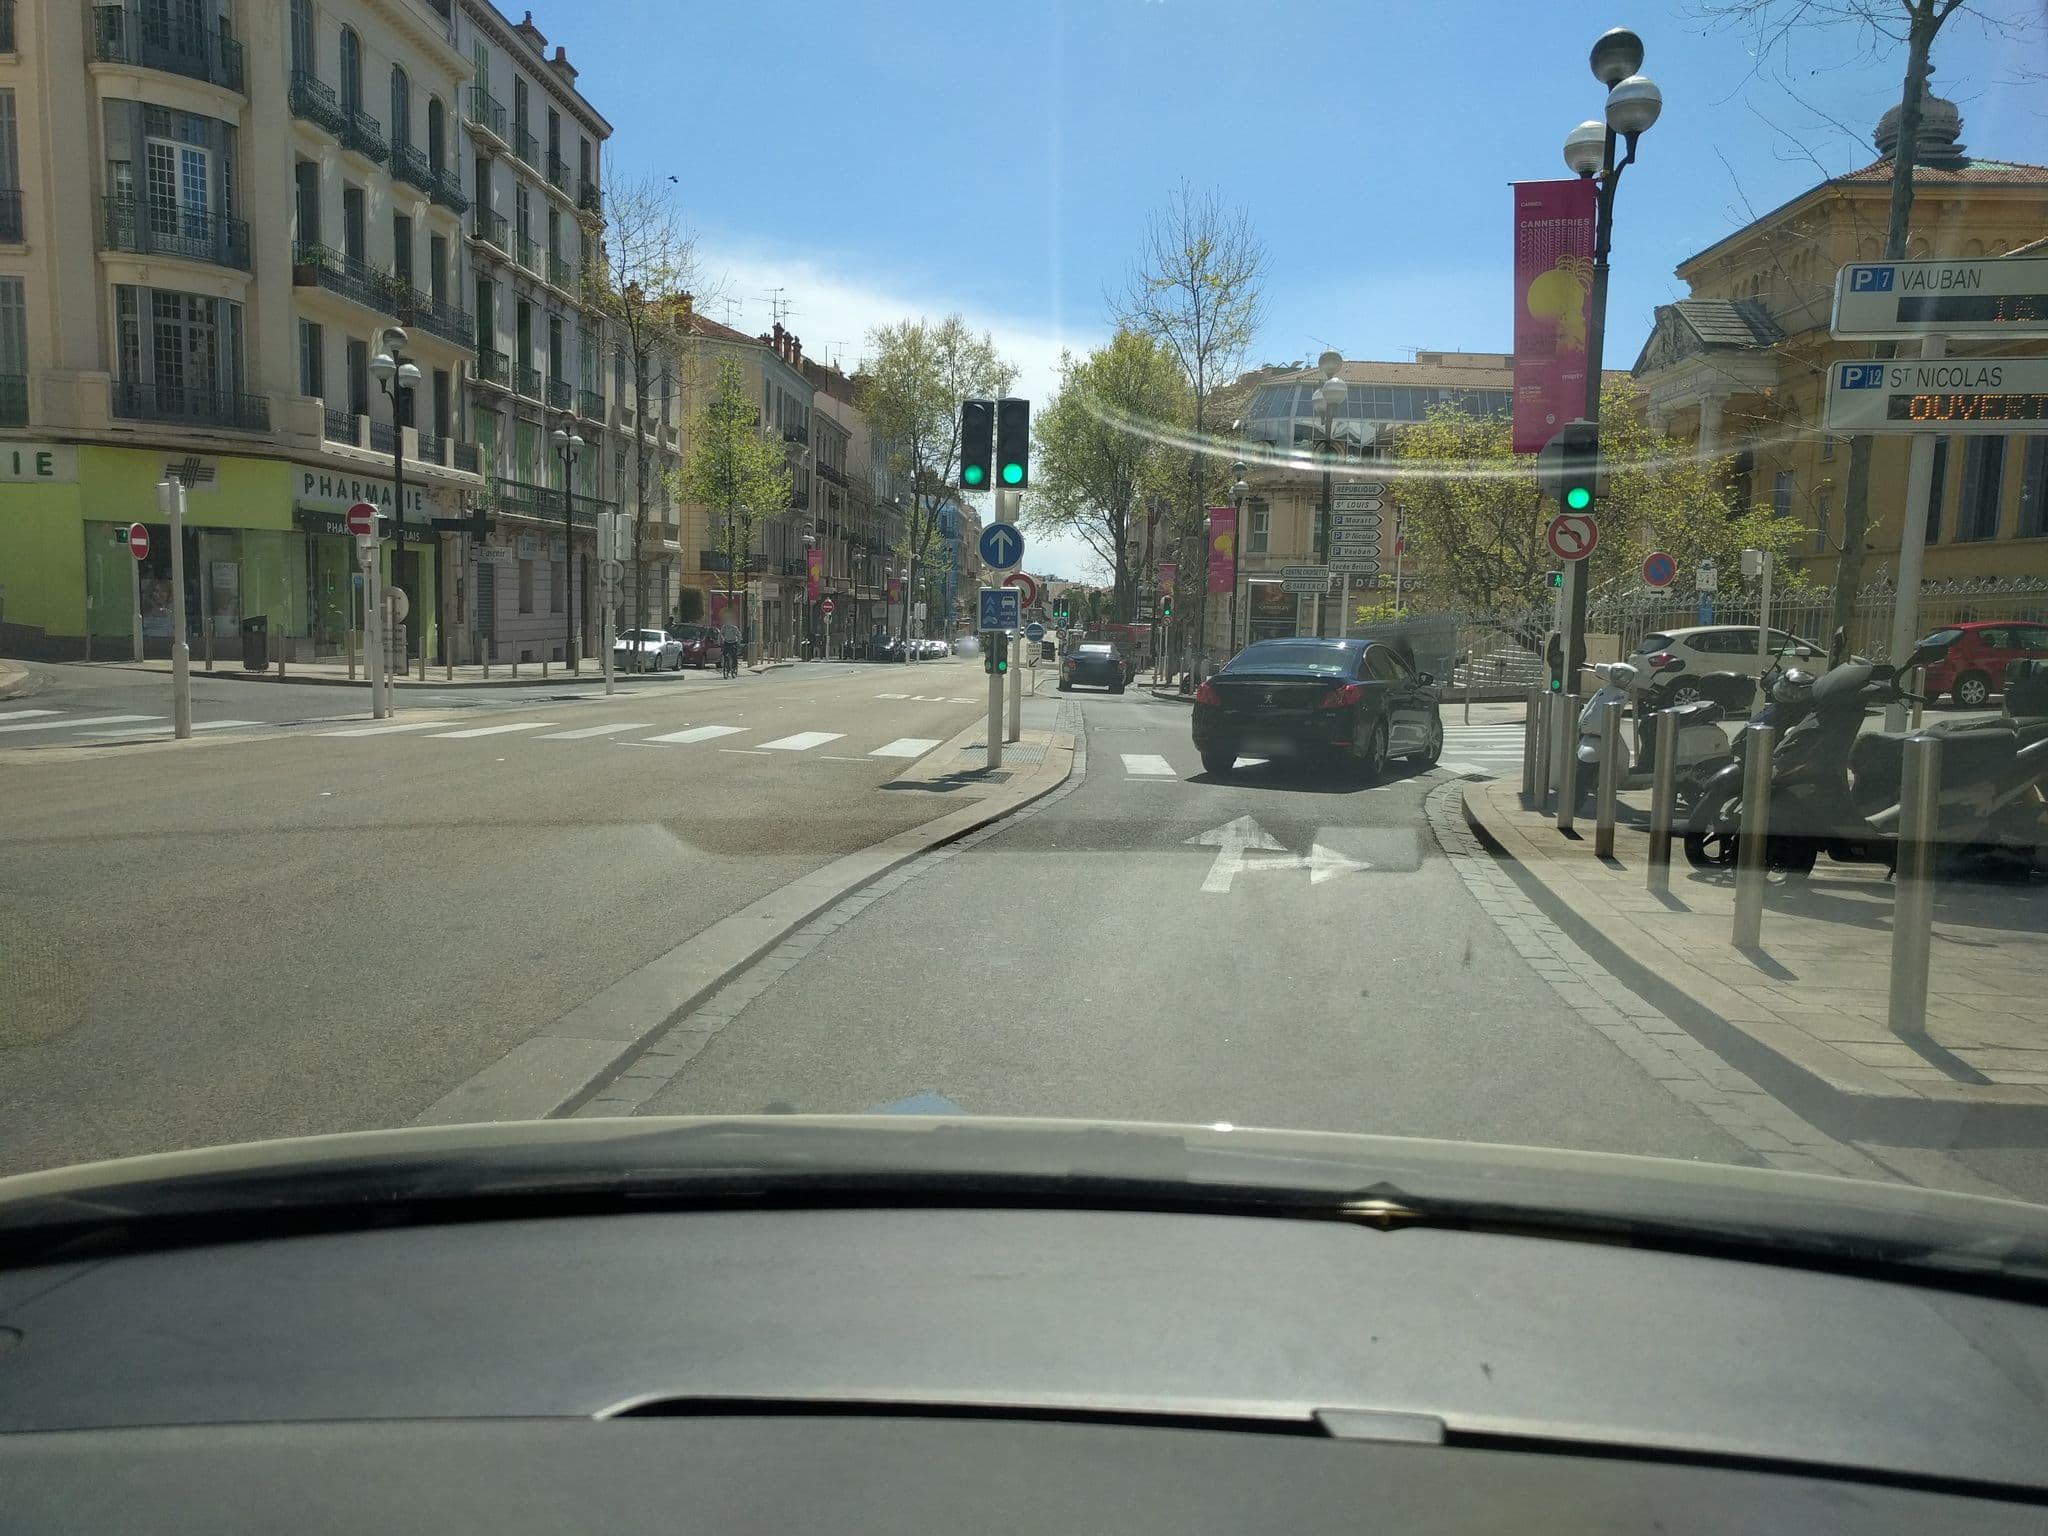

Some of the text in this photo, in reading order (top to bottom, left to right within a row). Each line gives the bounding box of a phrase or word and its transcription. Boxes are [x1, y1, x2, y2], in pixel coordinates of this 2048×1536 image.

[1520, 218, 1590, 229] CANNESERIES
[1882, 271, 1890, 288] 7
[1901, 268, 1982, 290] VAUBAN
[1868, 368, 1882, 385] 12
[1916, 366, 2003, 388] NICOLAS
[1909, 395, 2048, 420] OUVERT
[12, 450, 54, 476] IE
[303, 472, 423, 511] PHARMAIE
[1346, 501, 1370, 509] LOUIS
[1344, 547, 1372, 555] Vauban
